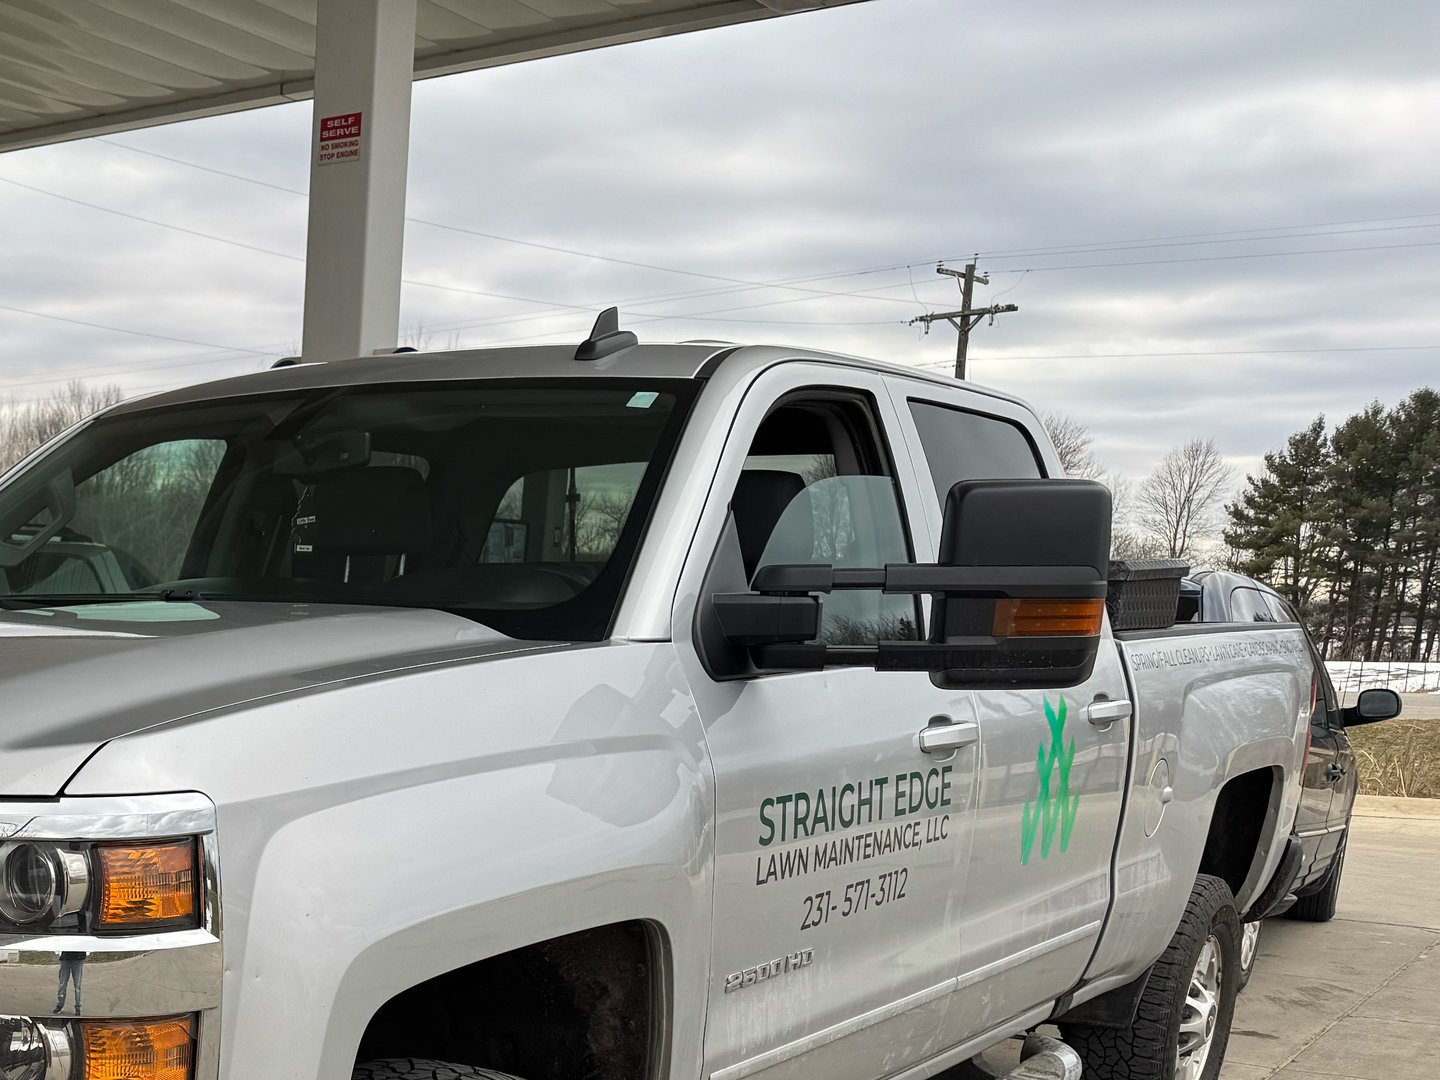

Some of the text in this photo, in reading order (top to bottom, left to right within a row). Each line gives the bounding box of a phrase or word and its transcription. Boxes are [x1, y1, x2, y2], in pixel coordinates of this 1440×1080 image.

[327, 117, 356, 128] SELF
[321, 126, 359, 138] SERVE
[319, 153, 335, 161] STOP
[758, 765, 953, 847] STRAIGHT EDGE
[756, 814, 950, 886] LAWN MAINTENANCE, LLC
